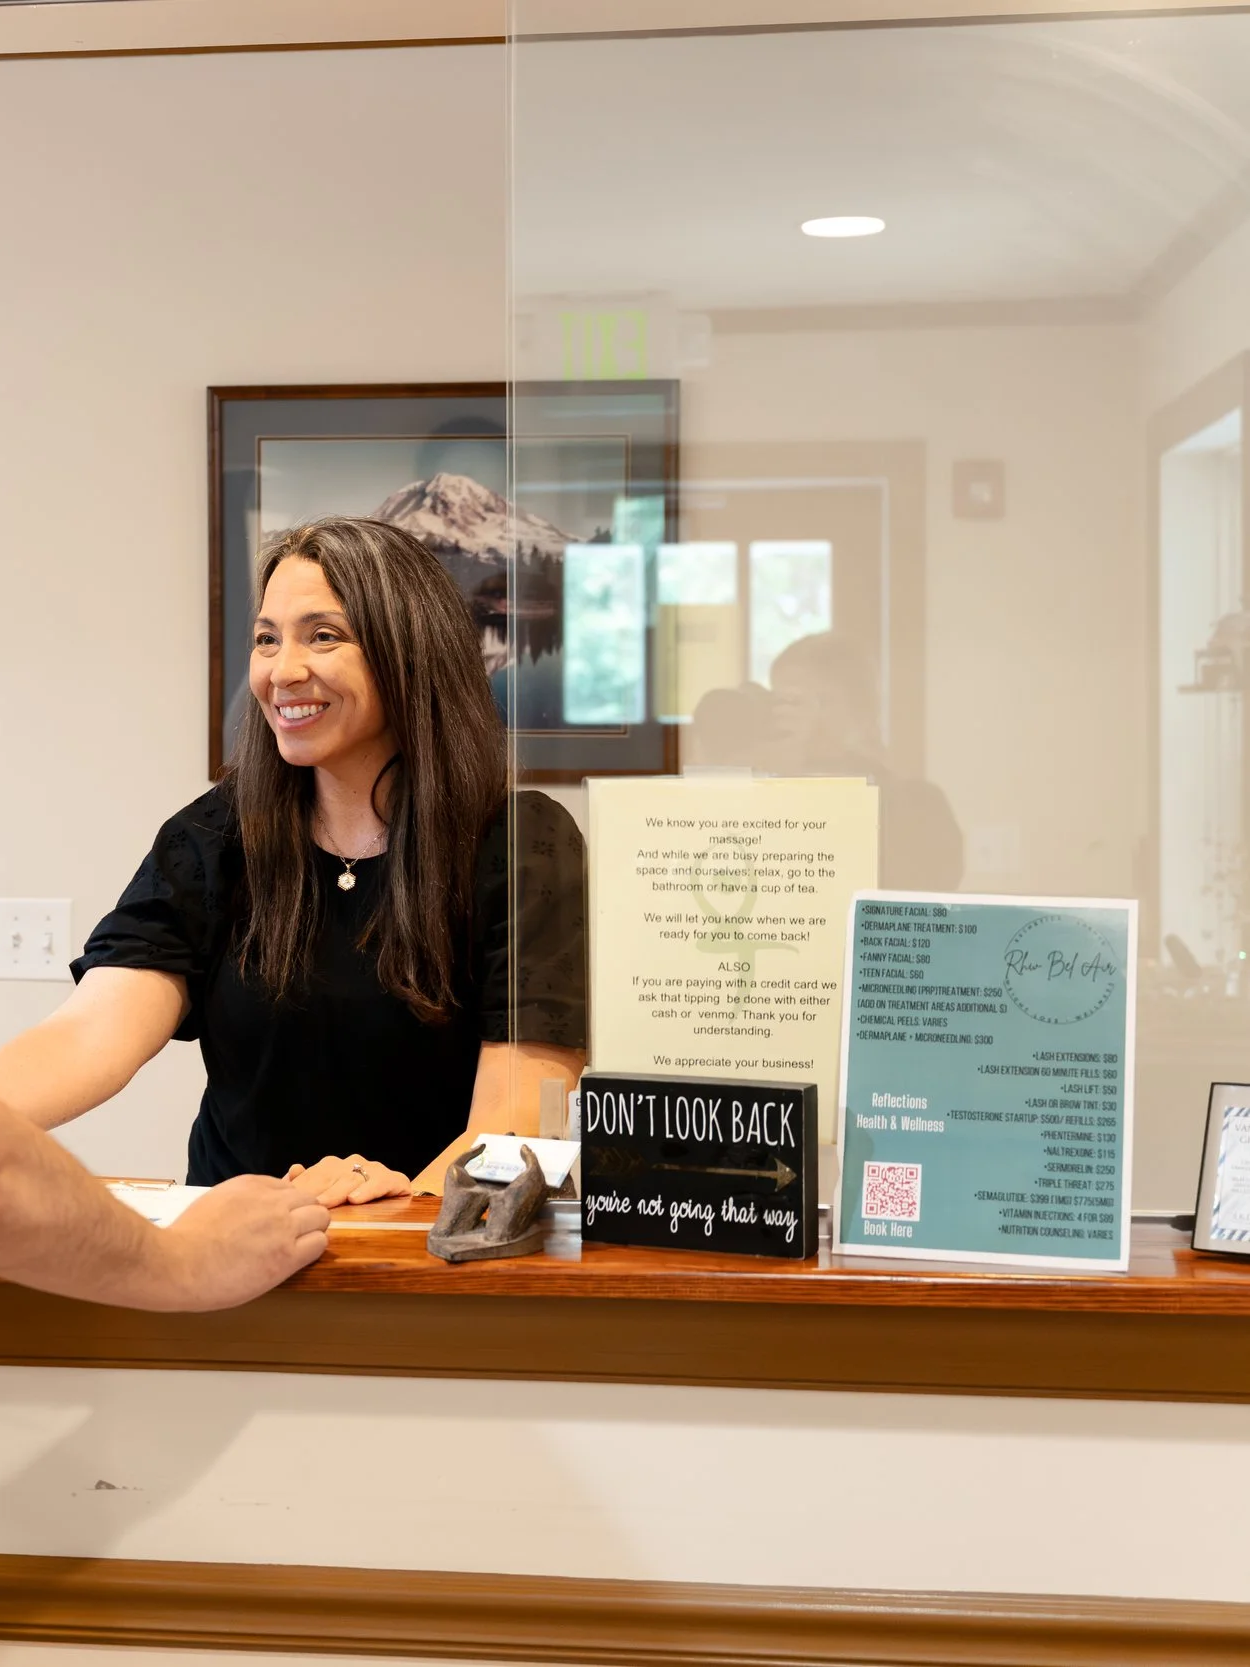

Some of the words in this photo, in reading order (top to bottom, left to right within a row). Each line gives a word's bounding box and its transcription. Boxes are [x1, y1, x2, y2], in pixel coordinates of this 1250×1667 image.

[646, 818, 663, 827] We
[667, 818, 695, 827] know
[699, 819, 718, 830] you
[743, 819, 781, 829] excited
[785, 819, 799, 829] for
[803, 821, 826, 831] your
[709, 835, 761, 845] massage!
[637, 850, 658, 859] And
[662, 850, 689, 860] while
[693, 852, 709, 860] we
[733, 851, 758, 863] busy
[762, 852, 813, 864] preparing
[817, 852, 834, 861] the
[636, 866, 668, 877] space
[672, 866, 691, 876] and
[754, 868, 783, 879] relax,
[788, 870, 801, 880] go
[805, 868, 814, 877] to
[818, 868, 835, 878] the
[652, 882, 703, 892] bathroom
[707, 884, 718, 892] or
[721, 883, 747, 893] have
[751, 885, 757, 893] a
[761, 885, 781, 895] cup
[785, 884, 795, 893] of
[798, 884, 818, 893] tea.
[865, 906, 902, 916] SIGNATURE
[905, 908, 930, 916] FACIAL:
[644, 913, 662, 923] We
[665, 913, 682, 923] will
[686, 914, 698, 923] let
[702, 916, 721, 926] you
[725, 915, 753, 924] know
[757, 915, 785, 925] when
[789, 917, 805, 925] we
[865, 921, 911, 932] DERMAPLANE
[914, 923, 957, 933] TREATMENT:
[959, 925, 977, 934] $100
[660, 930, 689, 941] ready
[693, 930, 707, 940] for
[711, 932, 730, 942] you
[734, 931, 743, 940] to
[747, 933, 777, 941] come
[781, 932, 810, 942] back!
[864, 937, 882, 946] BACK
[885, 938, 910, 947] FACIAL:
[912, 939, 930, 948] $120
[863, 953, 887, 962] FANNY
[888, 954, 914, 963] FACIAL:
[718, 962, 750, 972] ALSO
[1048, 950, 1078, 981] Bel
[863, 968, 880, 977] TEEN
[882, 969, 908, 978] FACIAL:
[633, 977, 640, 985] If
[642, 979, 662, 988] you
[686, 978, 722, 989] paying
[725, 978, 746, 987] with
[760, 979, 790, 989] credit
[794, 979, 818, 989] card
[639, 993, 657, 1002] ask
[661, 993, 681, 1003] that
[684, 993, 720, 1005] tipping
[727, 994, 740, 1004] be
[743, 995, 771, 1004] done
[774, 995, 796, 1005] with
[799, 996, 830, 1005] either
[652, 1009, 677, 1018] cash
[699, 1012, 738, 1020] venmo.
[743, 1010, 775, 1021] Thank
[779, 1013, 798, 1023] you
[802, 1011, 816, 1021] for
[861, 1015, 895, 1025] CHEMICAL
[922, 1018, 947, 1027] VARIES
[694, 1026, 773, 1038] understanding.
[654, 1056, 671, 1066] We
[675, 1057, 731, 1069] appreciate
[735, 1060, 758, 1069] your
[762, 1059, 813, 1069] business!
[872, 1093, 927, 1109] Reflections
[586, 1092, 656, 1137] DON'T
[665, 1096, 723, 1143] LOOK
[732, 1101, 795, 1147] BACK
[857, 1114, 887, 1130] Health
[890, 1115, 897, 1130] &
[901, 1116, 944, 1132] Wellness
[586, 1190, 631, 1225] you're
[637, 1195, 664, 1216] not
[670, 1199, 715, 1236] going
[721, 1197, 758, 1224] that
[763, 1209, 797, 1243] way
[864, 1220, 887, 1236] Book
[891, 1222, 912, 1238] Here
